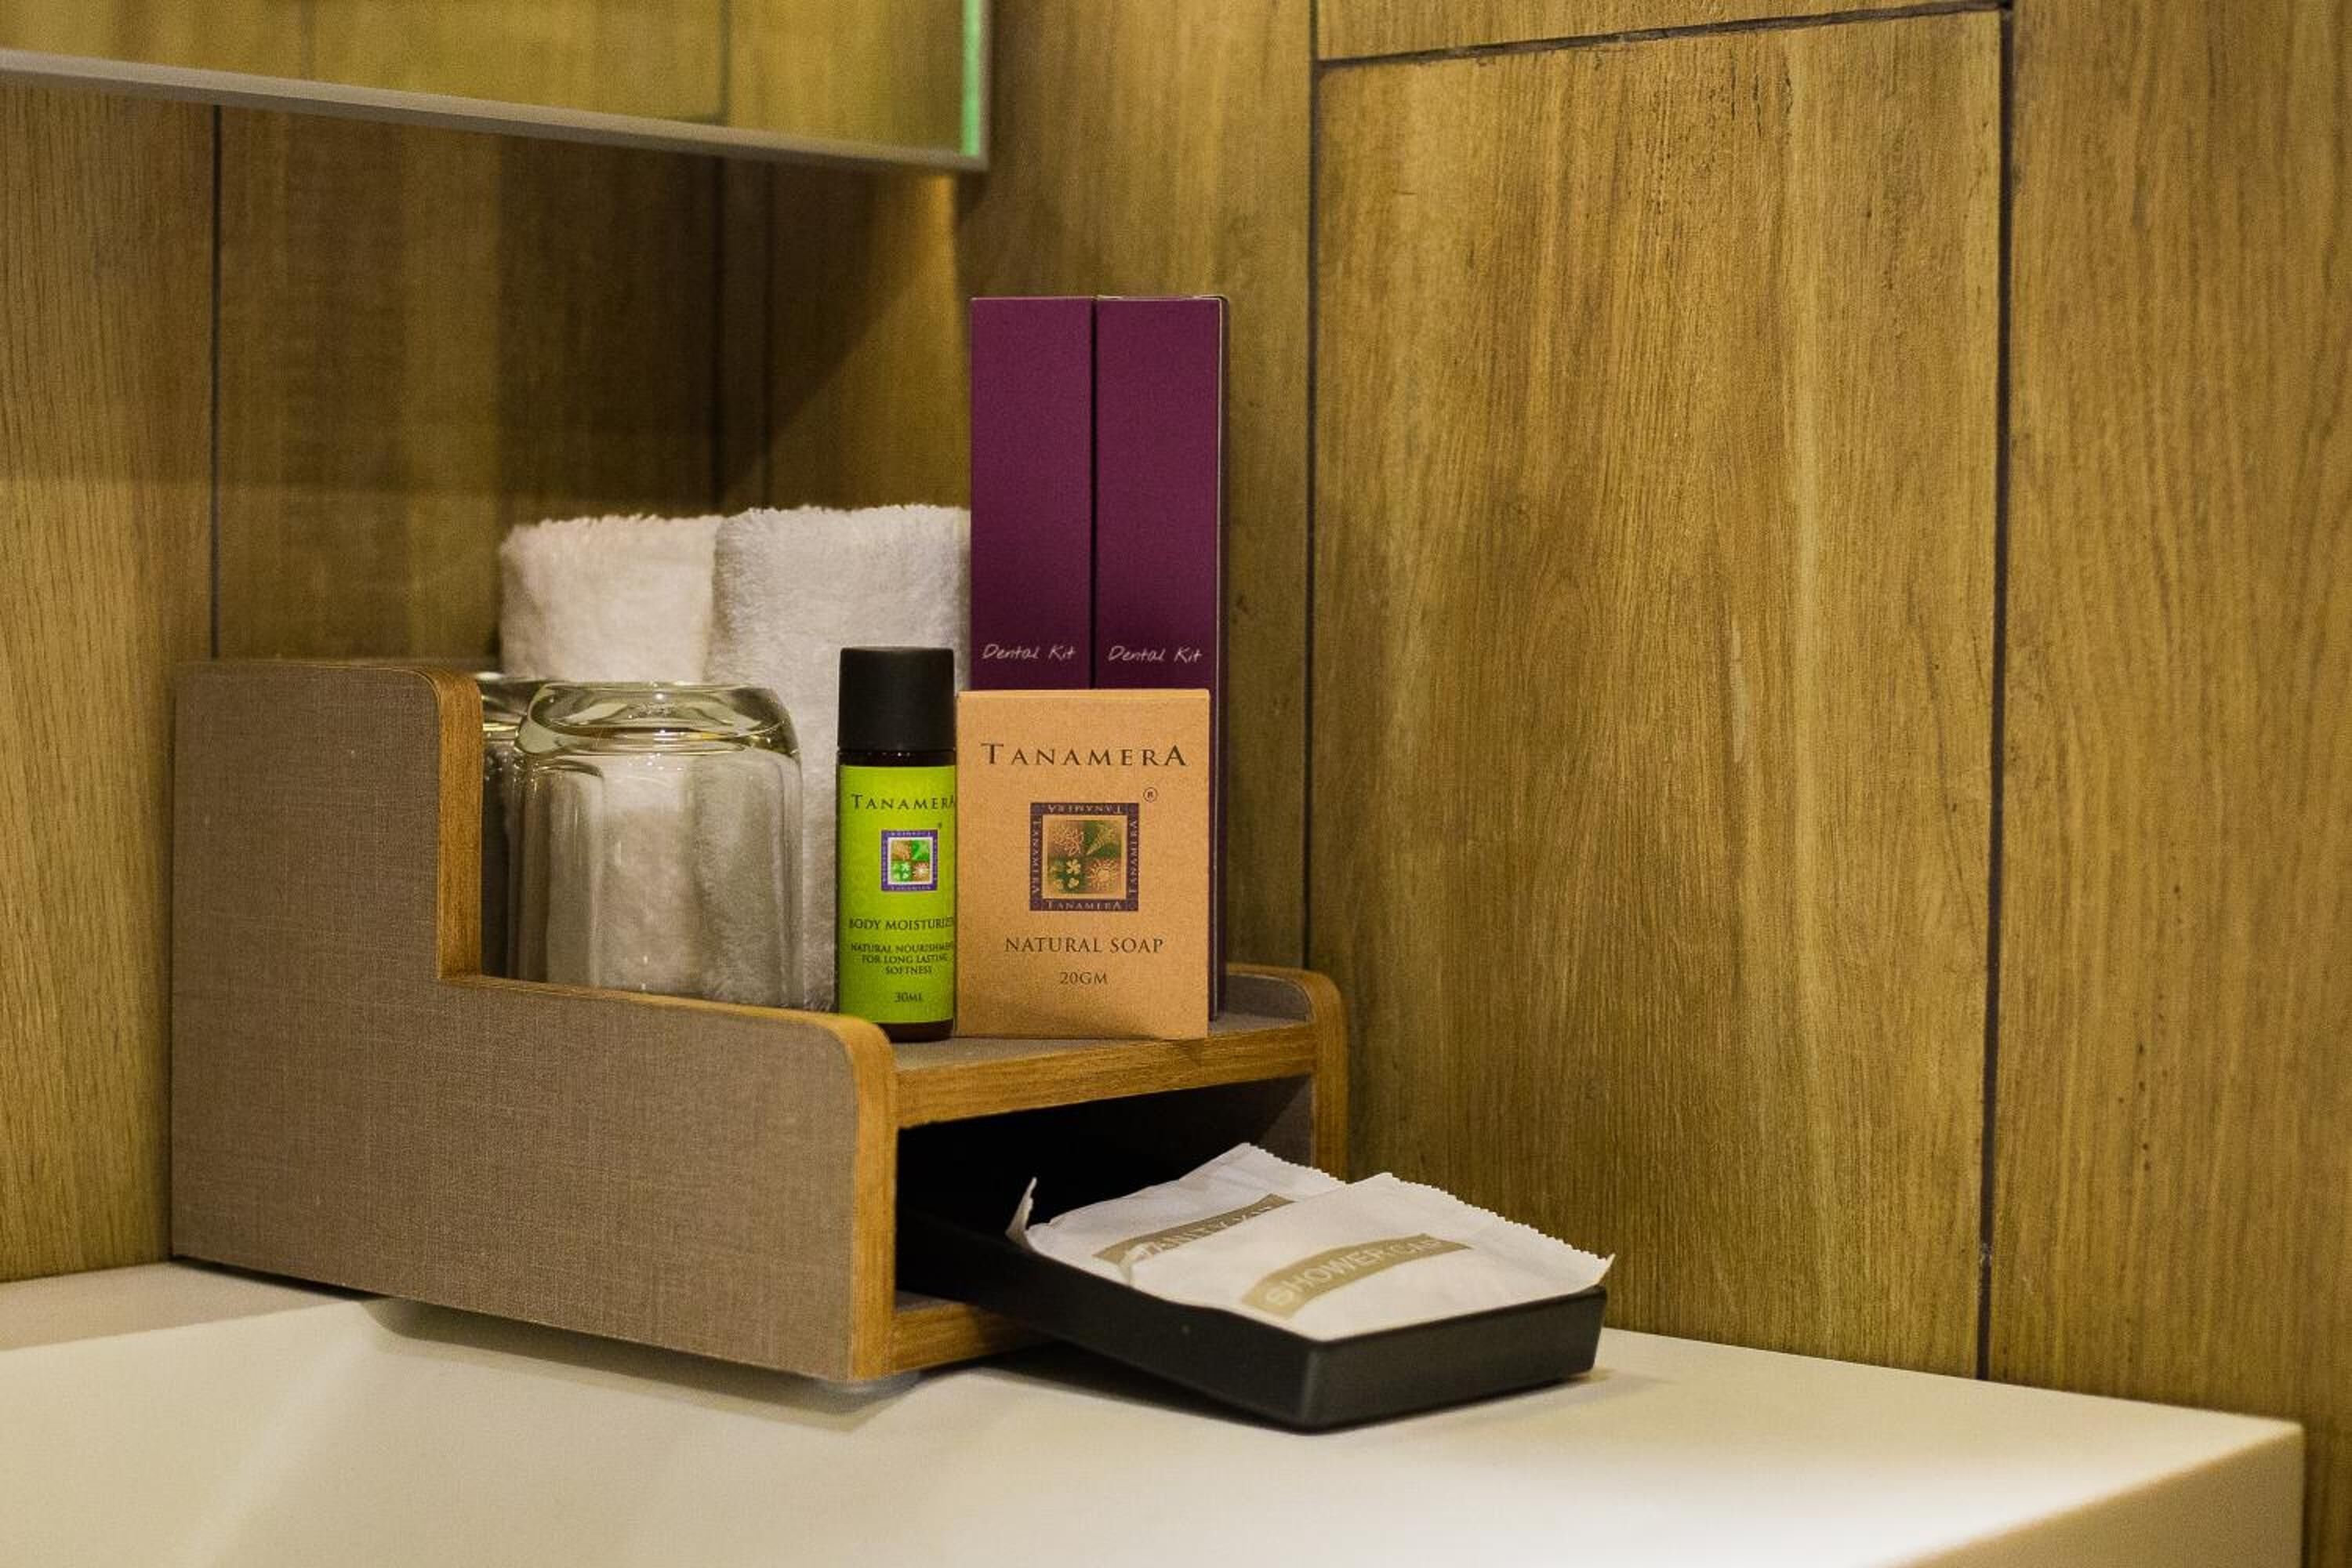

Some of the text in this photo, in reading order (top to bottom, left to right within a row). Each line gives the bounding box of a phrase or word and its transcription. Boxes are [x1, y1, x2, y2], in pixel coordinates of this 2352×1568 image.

[982, 644, 1076, 661] Dental Kit
[1108, 645, 1203, 662] Dental Kit
[980, 742, 1187, 766] TANAMERA
[849, 917, 881, 930] BODY
[851, 942, 891, 953] NATURAL
[1004, 937, 1164, 953] NATURAL SOAP
[862, 954, 880, 964] FOR
[884, 955, 913, 964] LONG
[884, 965, 932, 975] SOFTNESS
[1059, 971, 1108, 985] 20GM
[1265, 1248, 1385, 1305] SHOWER
